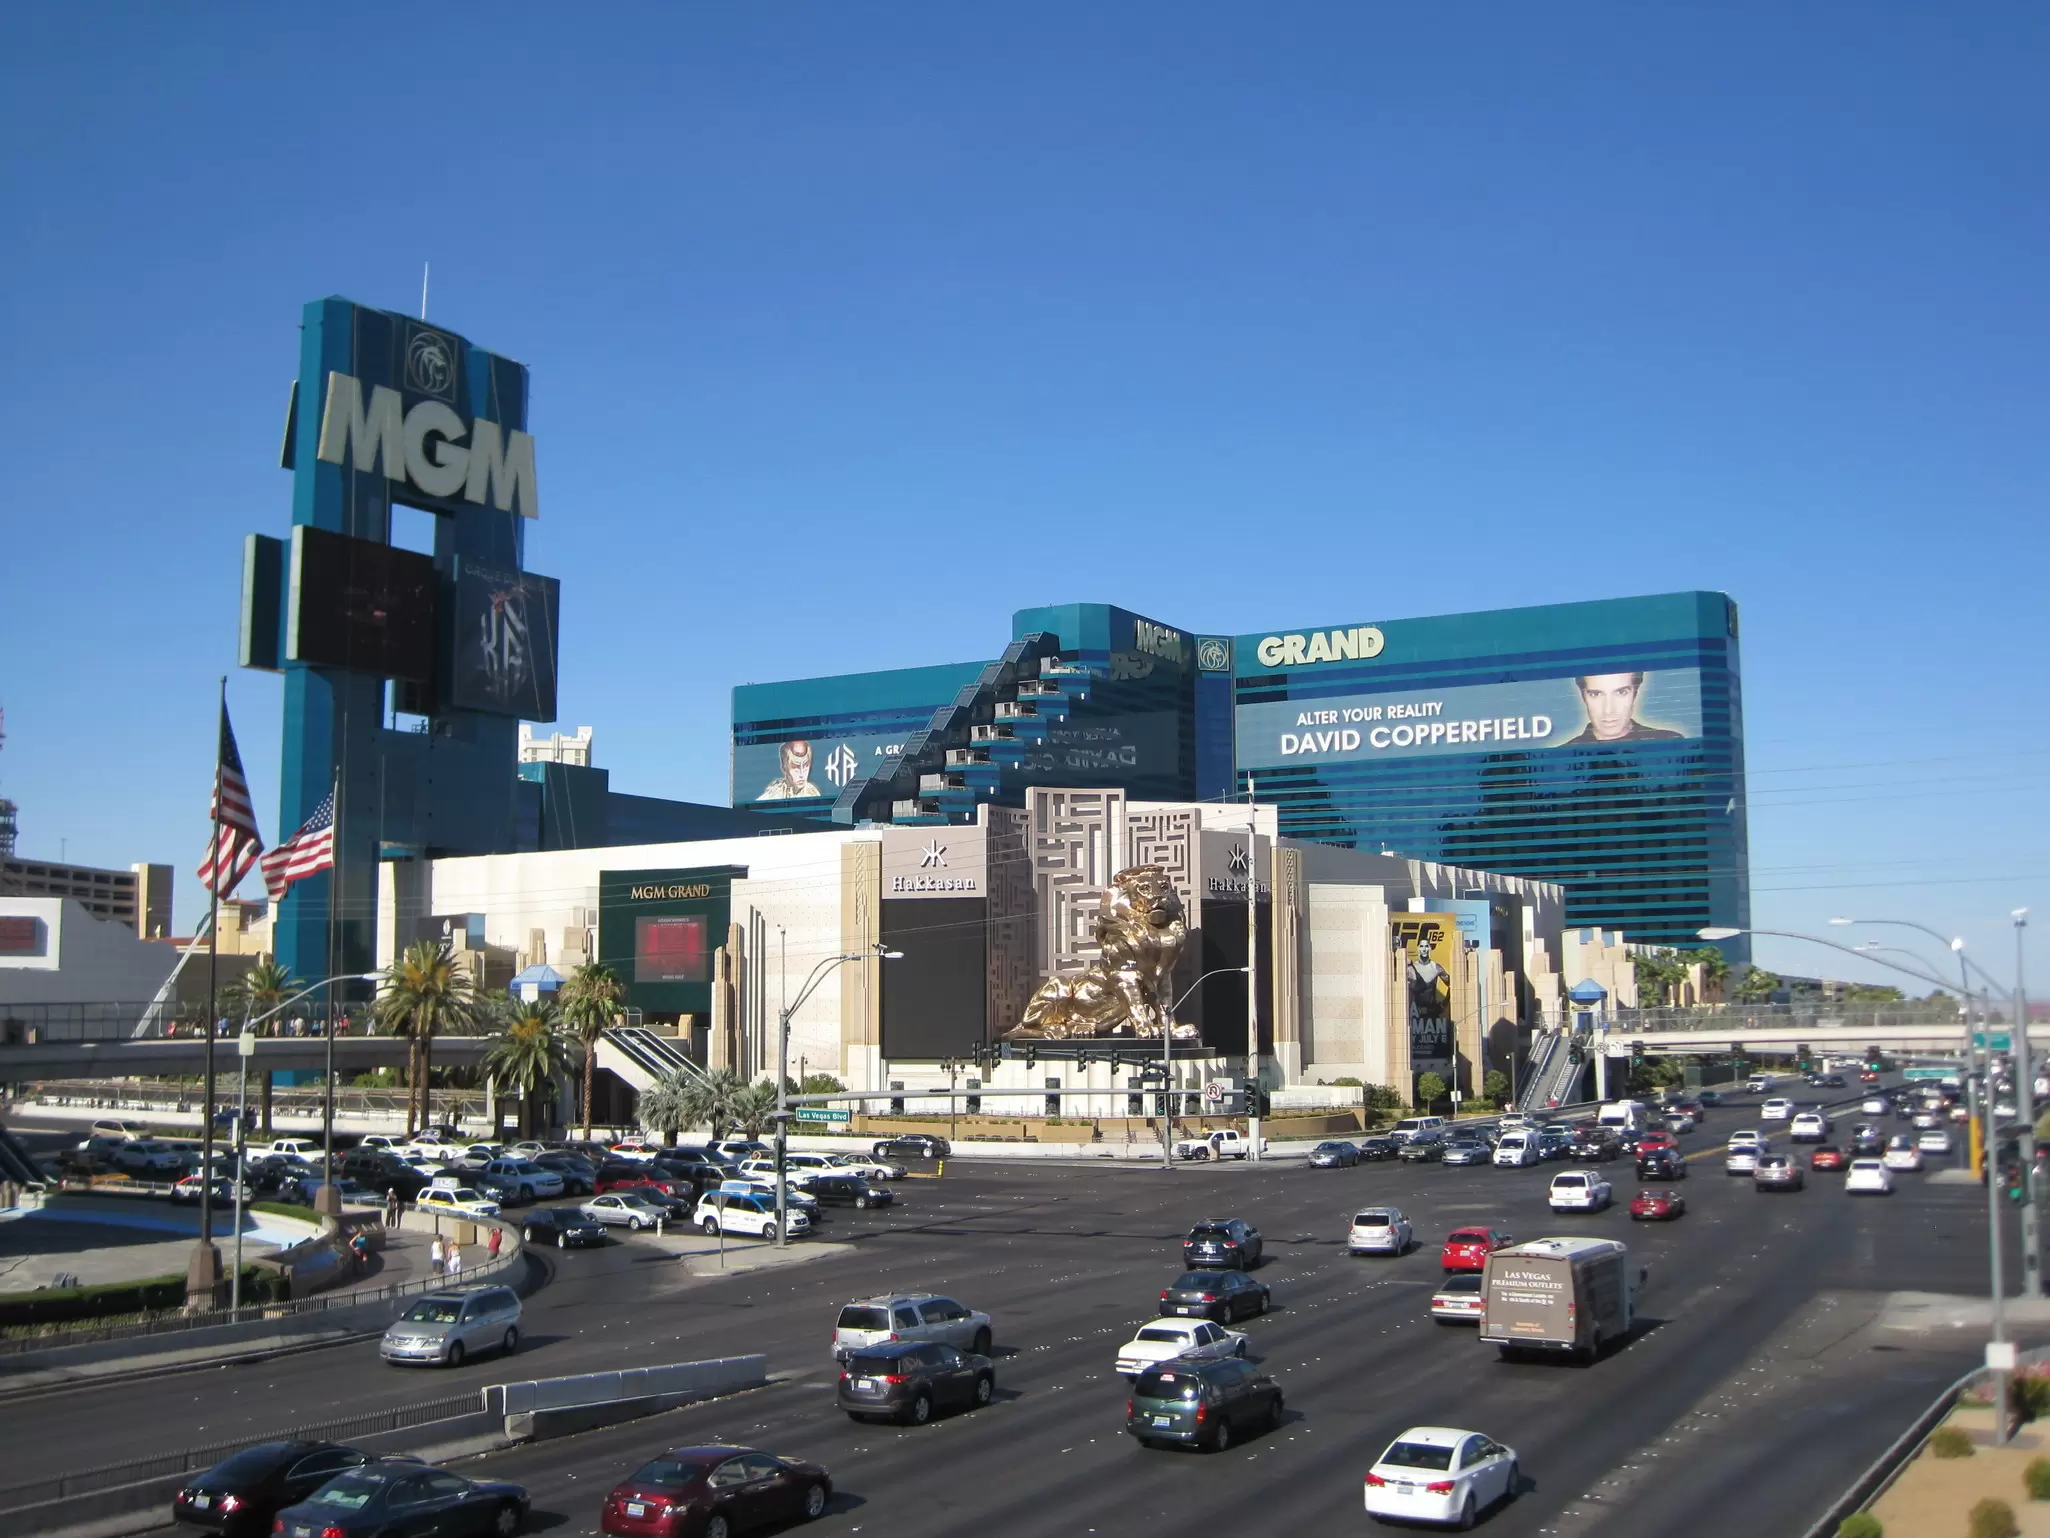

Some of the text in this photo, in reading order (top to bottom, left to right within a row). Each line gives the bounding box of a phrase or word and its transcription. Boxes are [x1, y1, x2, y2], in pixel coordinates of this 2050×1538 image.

[317, 370, 539, 519] MGM
[1135, 619, 1182, 664] MGM
[1257, 627, 1385, 668] GRAND
[1296, 702, 1443, 727] ALTER YOUR REALITY
[1281, 715, 1553, 755] DAVID COPPERFIELD
[891, 875, 977, 891] Hakkasan
[1209, 877, 1267, 893] Hakkaan
[631, 884, 711, 900] MGM GRAND
[798, 1111, 810, 1119] Las
[811, 1112, 831, 1121] Vegas
[1504, 1270, 1551, 1281] LAS VEGAS
[1491, 1279, 1564, 1290] PREMIUM OUTLETS
